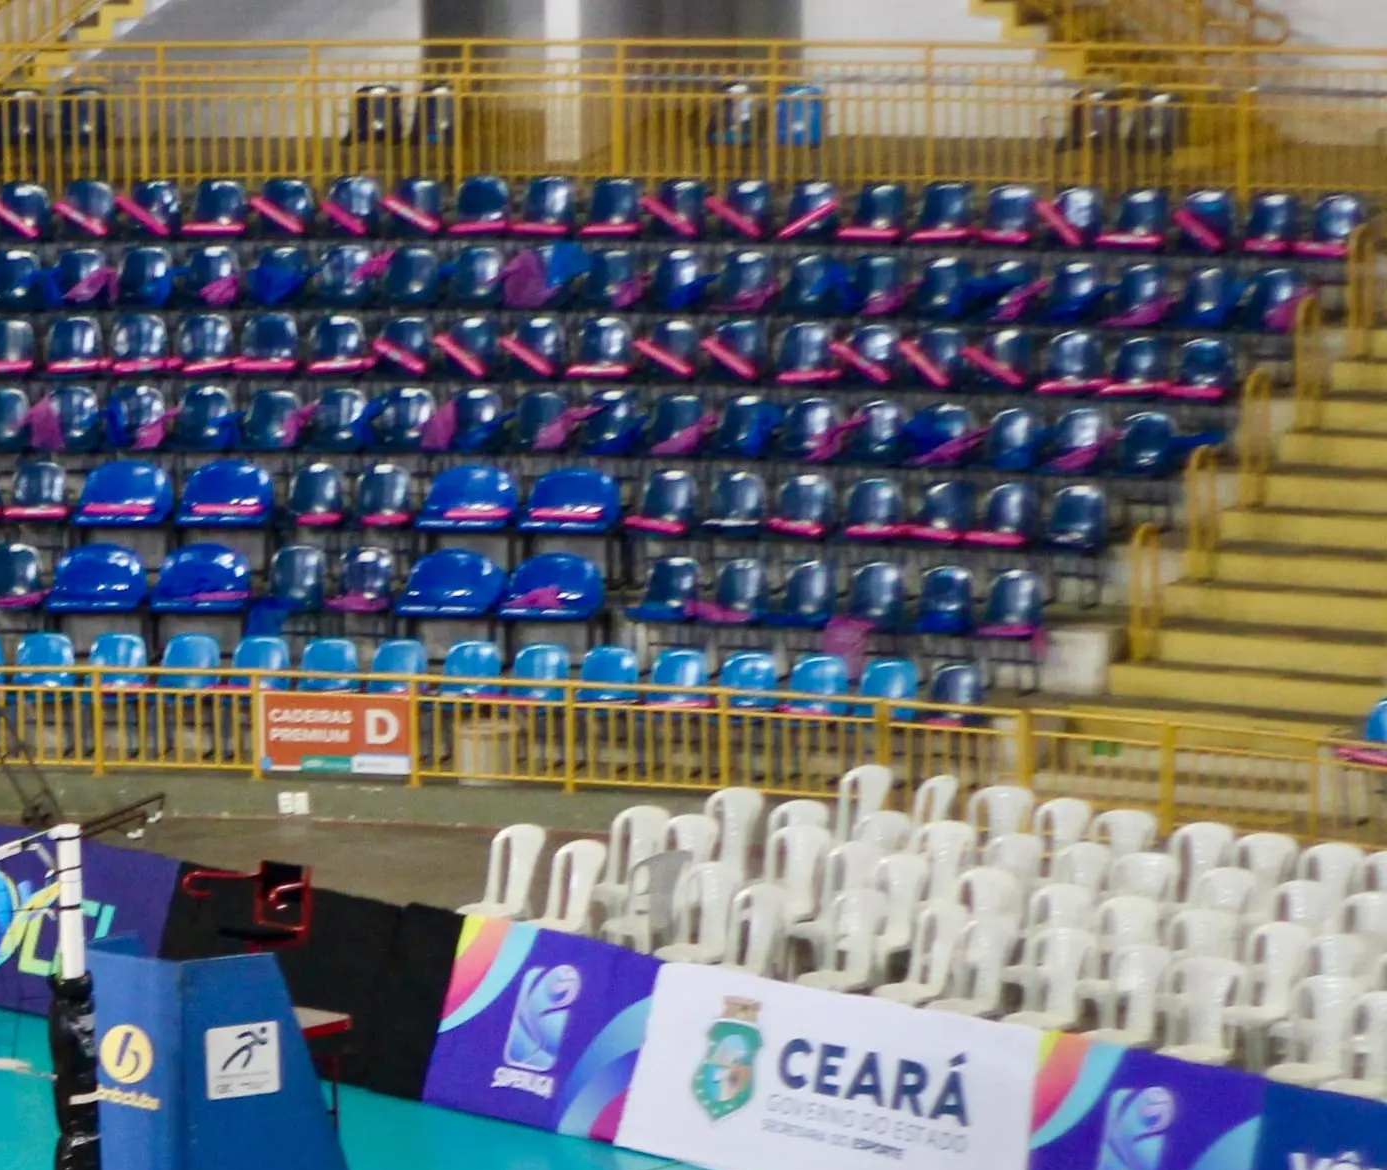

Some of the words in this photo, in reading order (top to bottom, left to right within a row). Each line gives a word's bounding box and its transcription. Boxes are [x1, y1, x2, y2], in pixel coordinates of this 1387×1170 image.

[268, 708, 353, 724] CADEIRAS
[364, 708, 401, 745] D
[269, 728, 351, 743] PREMIUM
[778, 1037, 970, 1128] CEARÁ
[765, 1093, 855, 1129] GOVERNO
[893, 1120, 970, 1154] ESTADO
